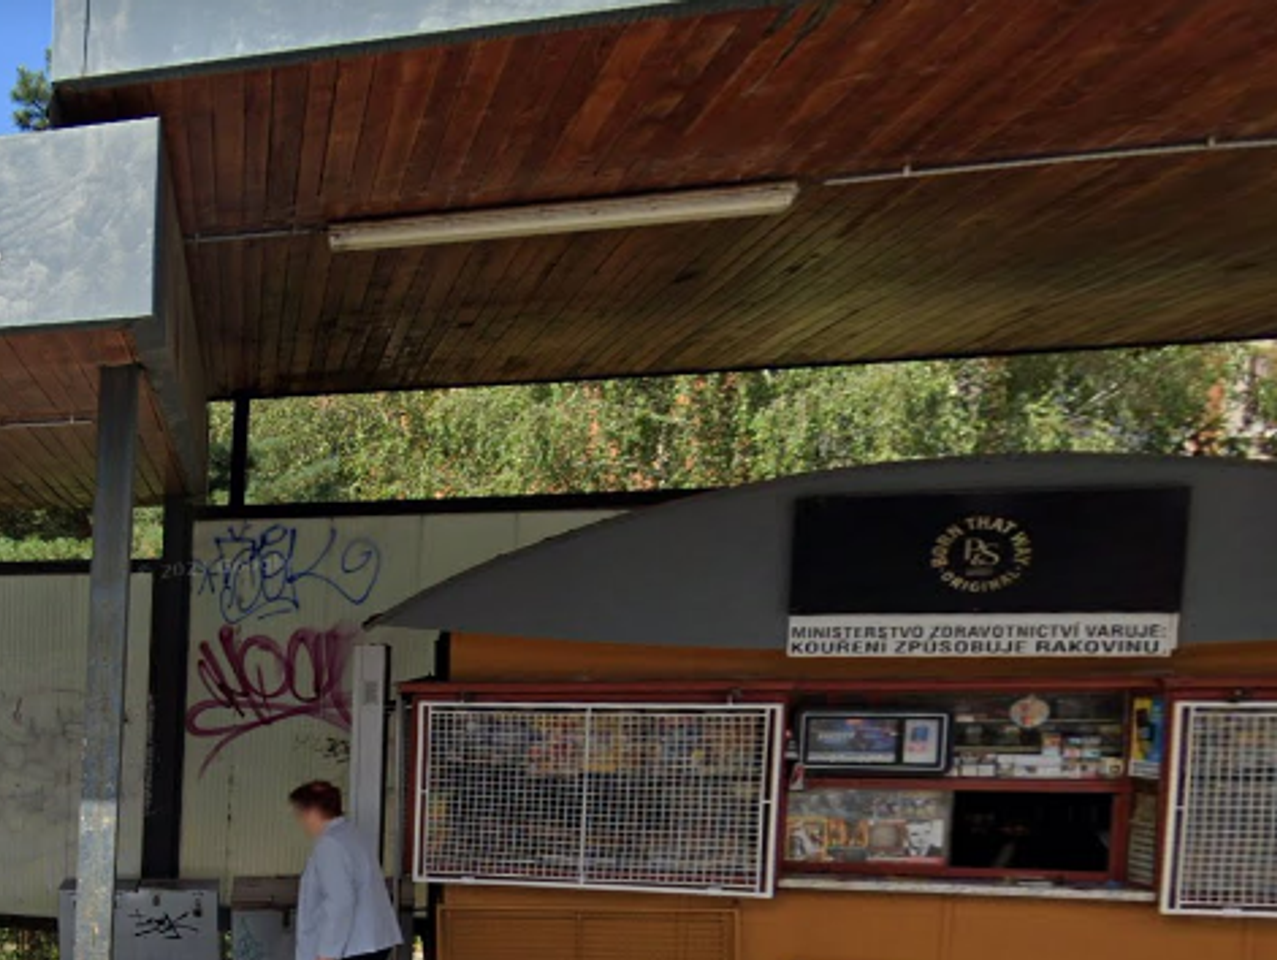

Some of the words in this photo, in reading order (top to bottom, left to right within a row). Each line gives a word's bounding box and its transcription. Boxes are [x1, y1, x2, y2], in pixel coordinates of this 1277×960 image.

[930, 523, 964, 568] BORN
[965, 516, 1018, 534] THAT
[1010, 531, 1033, 567] WAY
[940, 570, 1022, 592] ORIGINAL
[791, 625, 924, 640] MINISTERSTVO
[930, 621, 1079, 640] ZDRAVOTNICTVÍ
